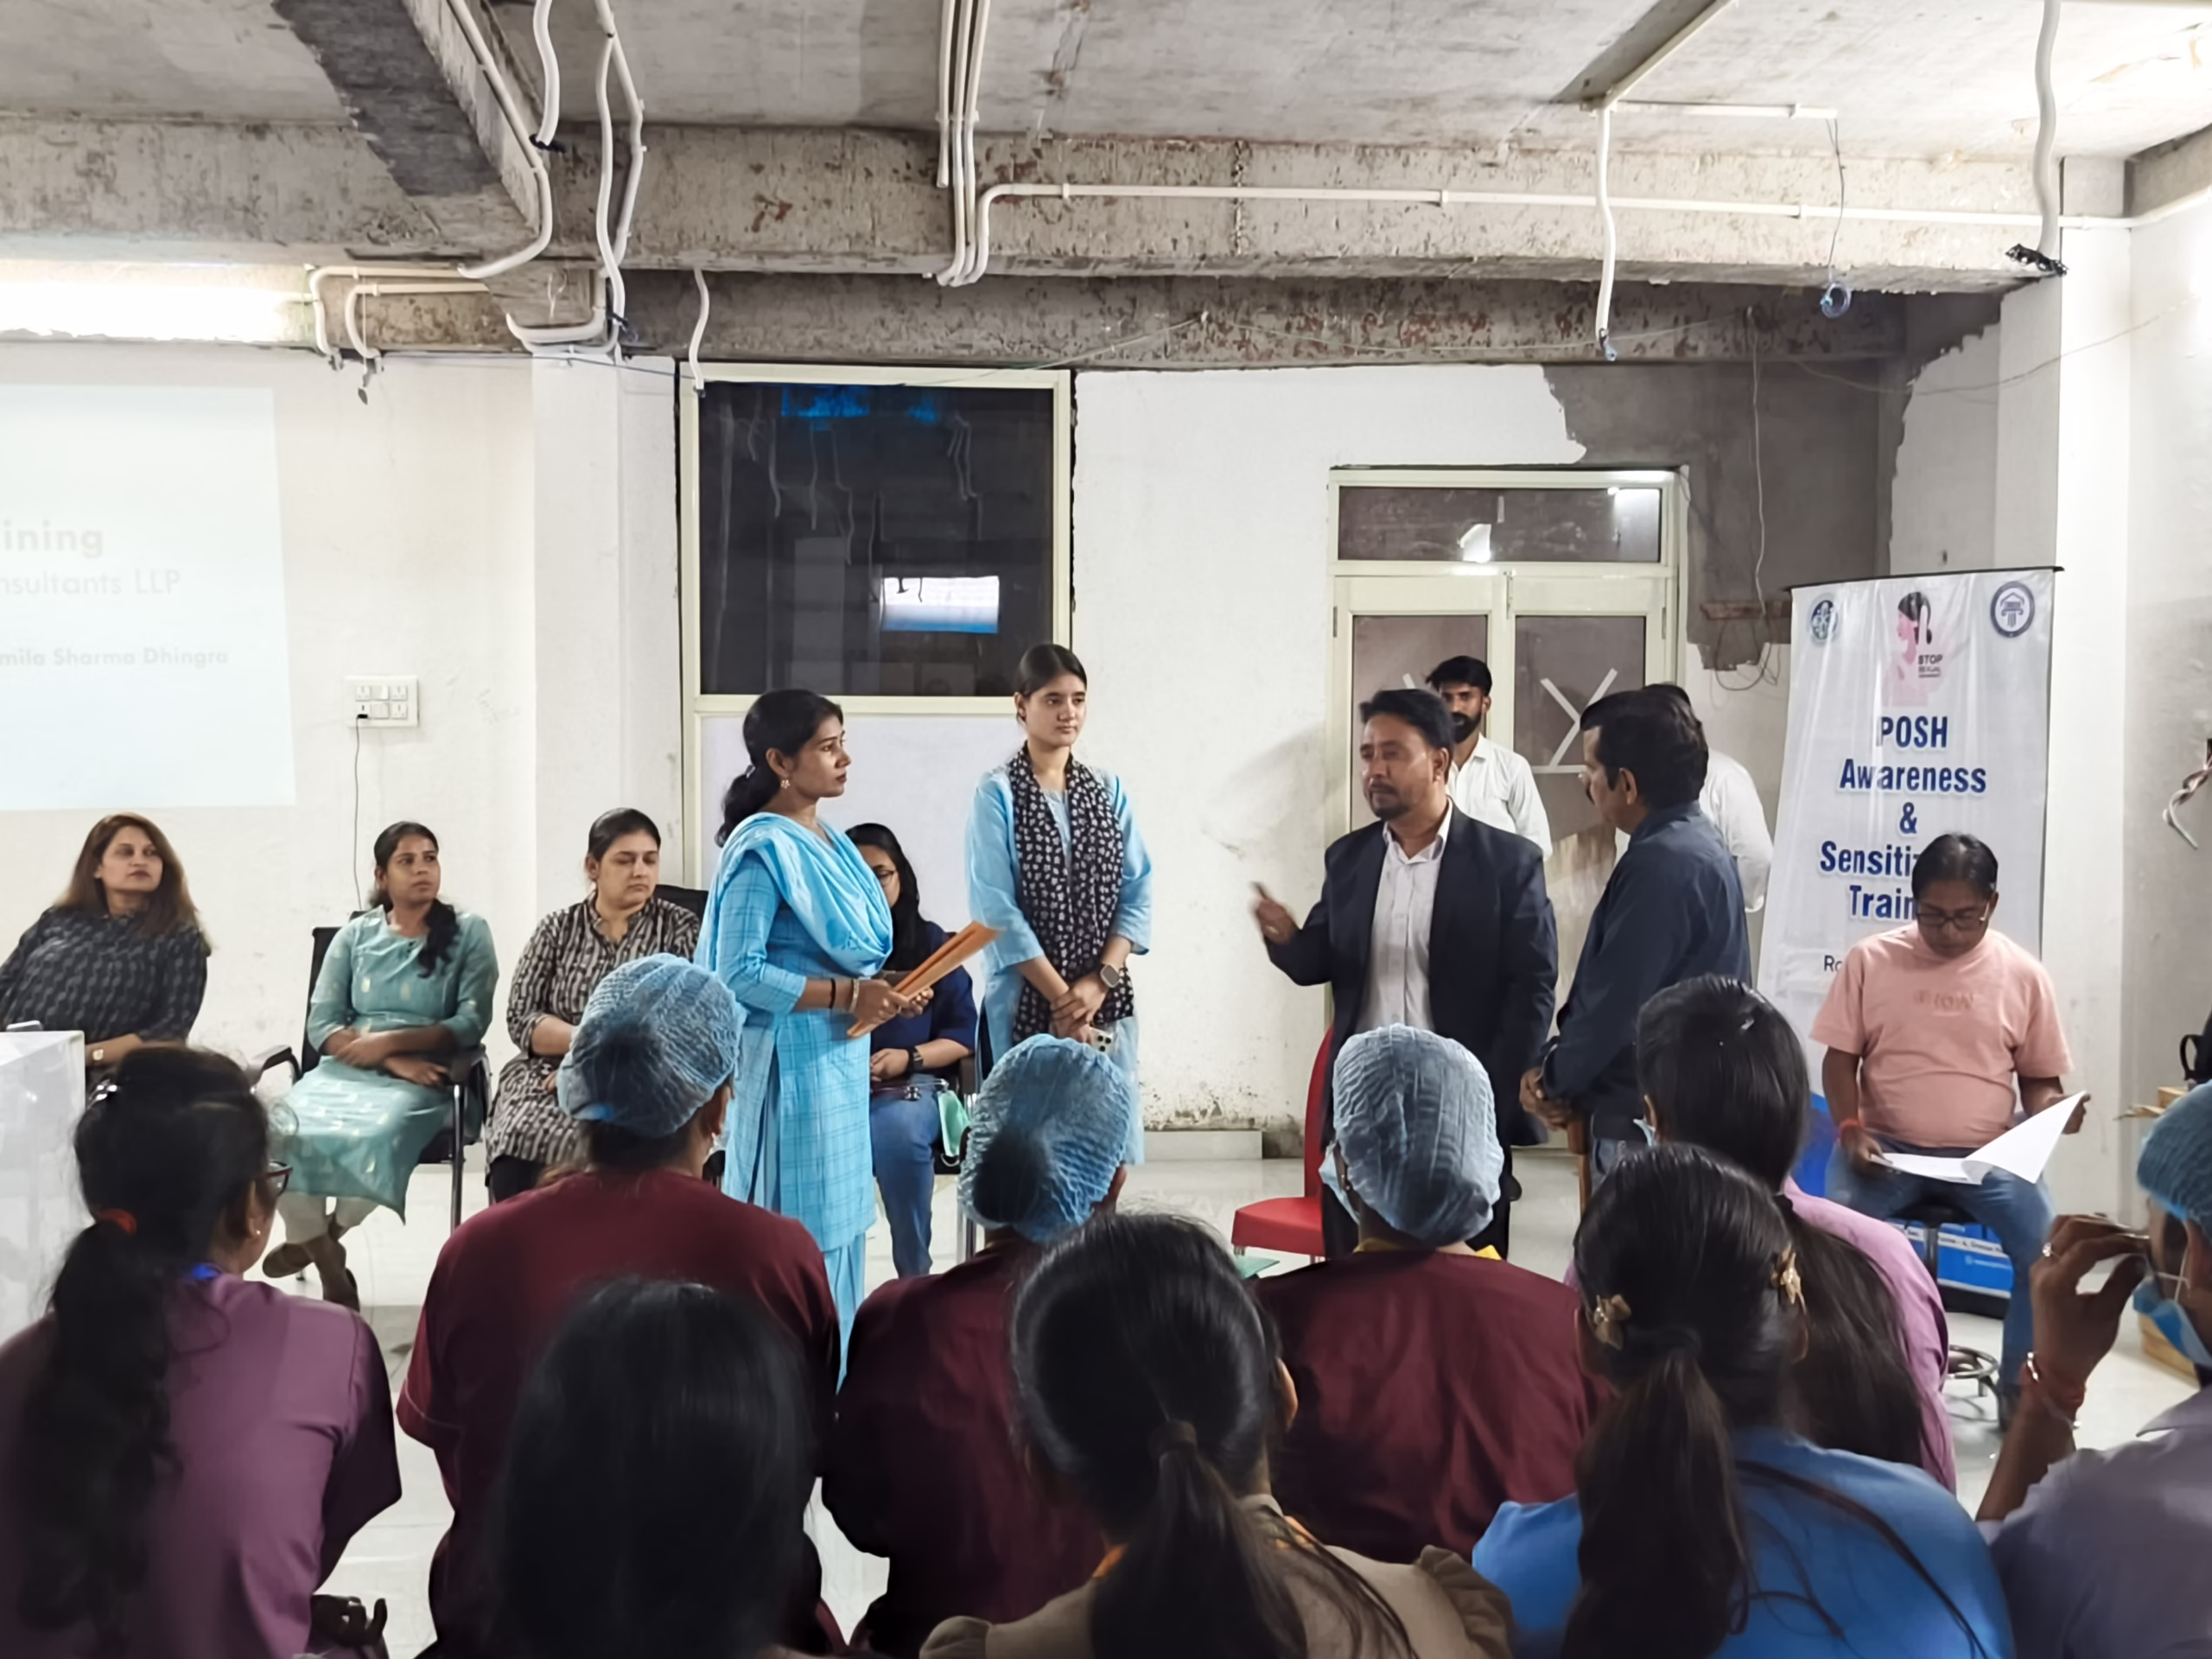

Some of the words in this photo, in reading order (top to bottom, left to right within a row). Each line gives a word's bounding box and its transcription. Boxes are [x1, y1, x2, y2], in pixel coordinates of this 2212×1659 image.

[134, 568, 181, 595] LLP
[52, 646, 137, 666] Sharma
[143, 646, 229, 671] Dhingra
[1918, 653, 1943, 665] STOP
[1876, 715, 1948, 748] POSH
[1839, 758, 1987, 793] Awareness
[1899, 802, 1918, 834] &
